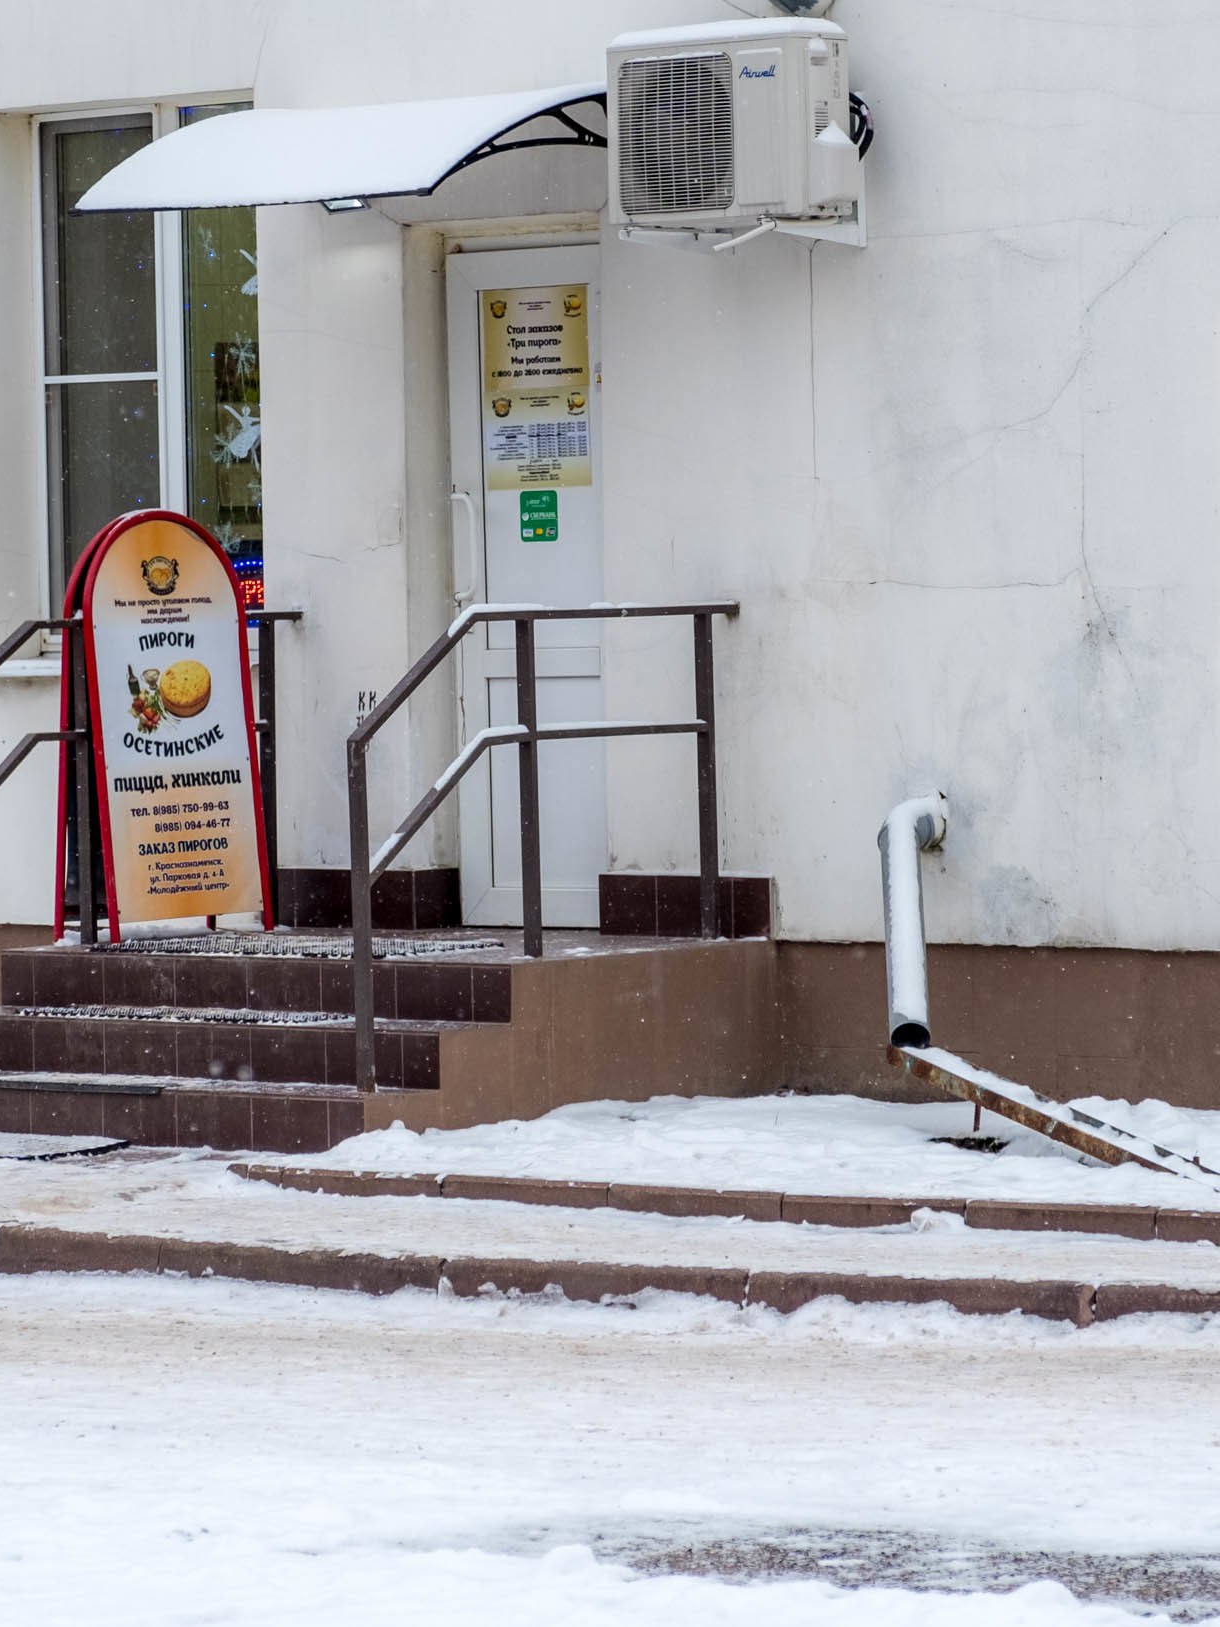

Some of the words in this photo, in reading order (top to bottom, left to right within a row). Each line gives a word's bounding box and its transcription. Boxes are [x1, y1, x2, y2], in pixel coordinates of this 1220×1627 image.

[738, 65, 776, 79] Airwell
[506, 325, 526, 334] Стол
[139, 631, 195, 652] ПИРОГИ
[123, 723, 224, 758] ОСЕТИНСКИЕ
[114, 774, 168, 795] пицца,
[171, 769, 242, 789] хинкали
[130, 807, 151, 818] тел.
[152, 803, 181, 816] 8(985)
[154, 821, 182, 834] 8(985)
[138, 842, 176, 856] ЗАКАЗ
[177, 837, 229, 853] ПИРОГОВ
